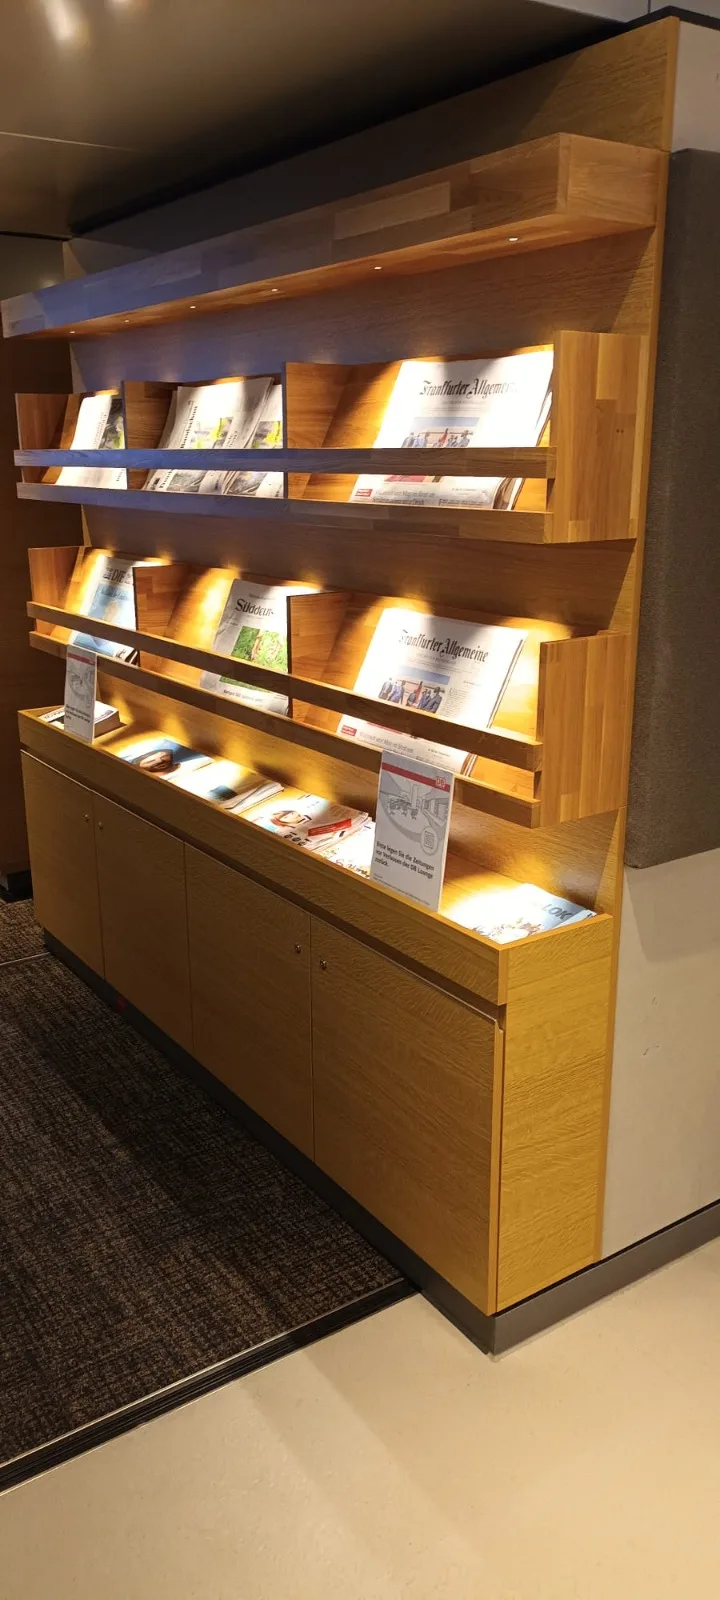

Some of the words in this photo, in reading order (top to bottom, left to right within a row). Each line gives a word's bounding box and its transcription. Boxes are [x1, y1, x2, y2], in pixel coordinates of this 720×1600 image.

[419, 379, 470, 396] Frankfurter
[398, 628, 443, 653] Frankfurter
[440, 637, 489, 662] Allgemeine
[377, 841, 386, 850] Bitte
[387, 845, 398, 855] legen
[413, 857, 434, 870] Zeitungen
[383, 852, 401, 864] Verlassen
[418, 868, 433, 879] Lounge
